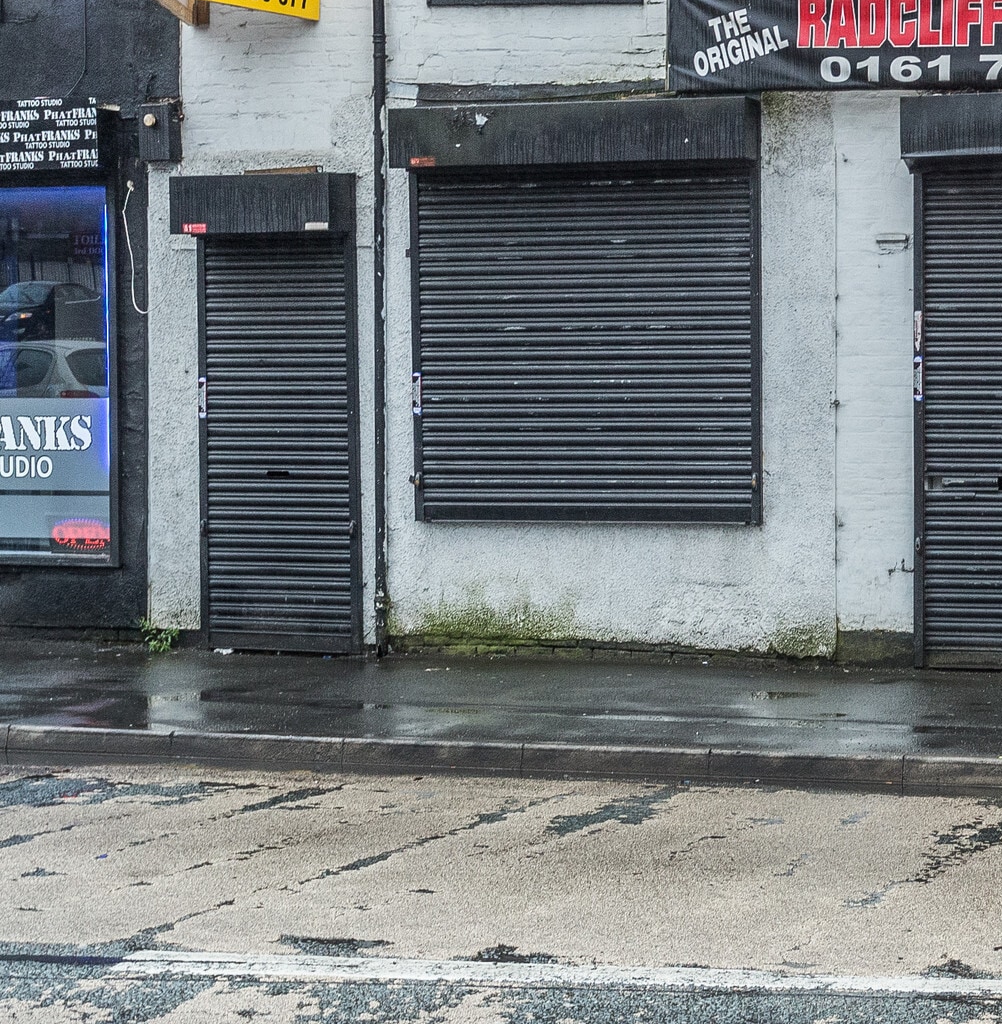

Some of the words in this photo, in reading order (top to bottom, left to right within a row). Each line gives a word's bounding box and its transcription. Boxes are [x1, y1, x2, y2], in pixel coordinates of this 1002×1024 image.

[708, 7, 749, 43] THE
[693, 25, 789, 77] ORIGINAL
[819, 54, 951, 83] 0161
[17, 99, 40, 107] TATTOO
[41, 98, 63, 107] STUDIO
[8, 121, 30, 129] STUDIO
[56, 119, 79, 127] TATTOO
[48, 141, 70, 149] STUDIO
[13, 162, 35, 170] STUDIO
[60, 161, 83, 169] TATTOO
[0, 455, 53, 478] UDIO
